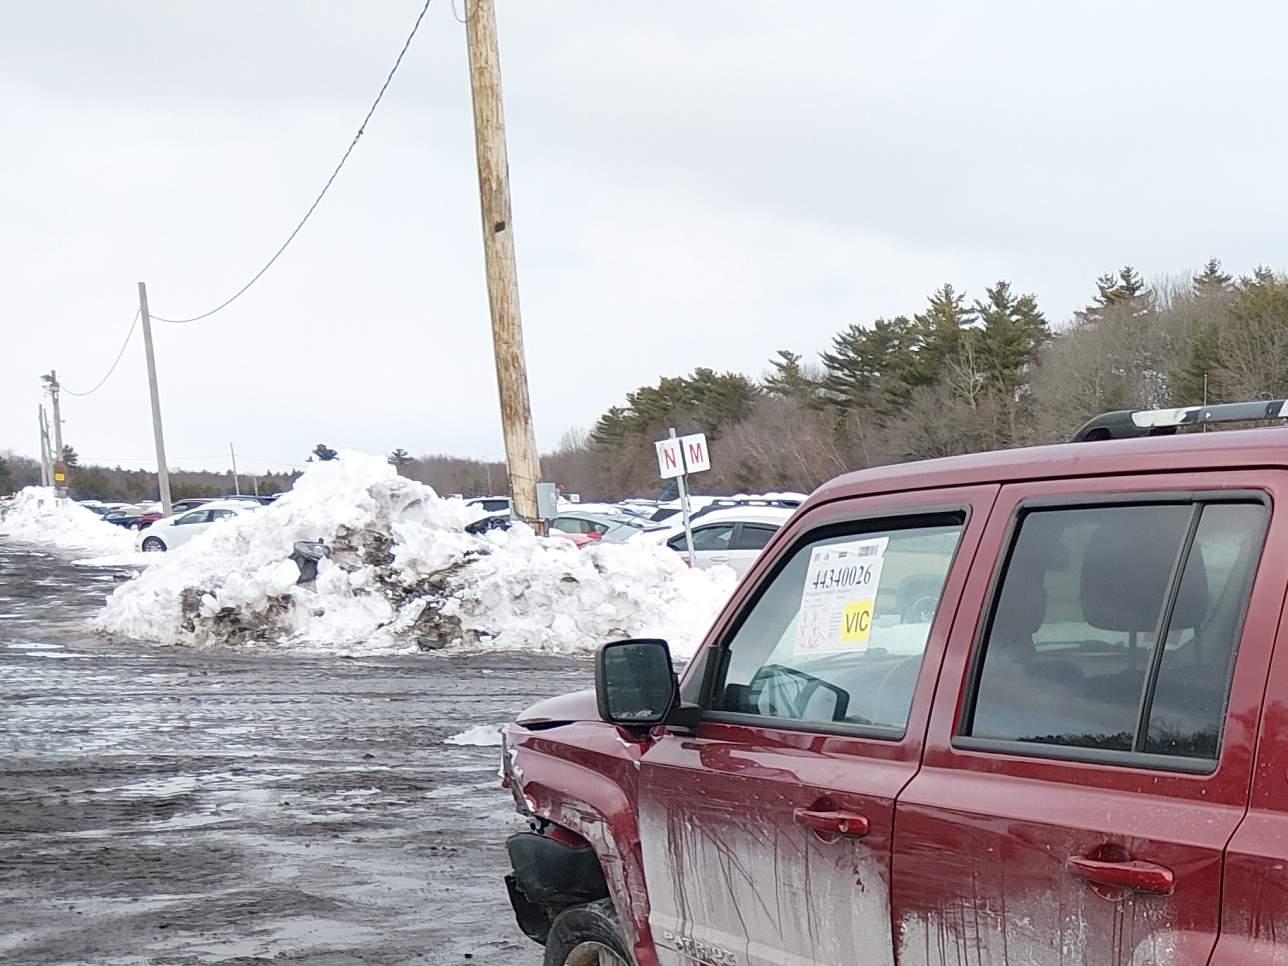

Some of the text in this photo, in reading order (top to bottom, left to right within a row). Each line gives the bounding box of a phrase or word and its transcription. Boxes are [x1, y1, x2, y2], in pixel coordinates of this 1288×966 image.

[663, 442, 704, 470] N M
[812, 564, 872, 590] 44340026
[845, 610, 870, 634] VIC
